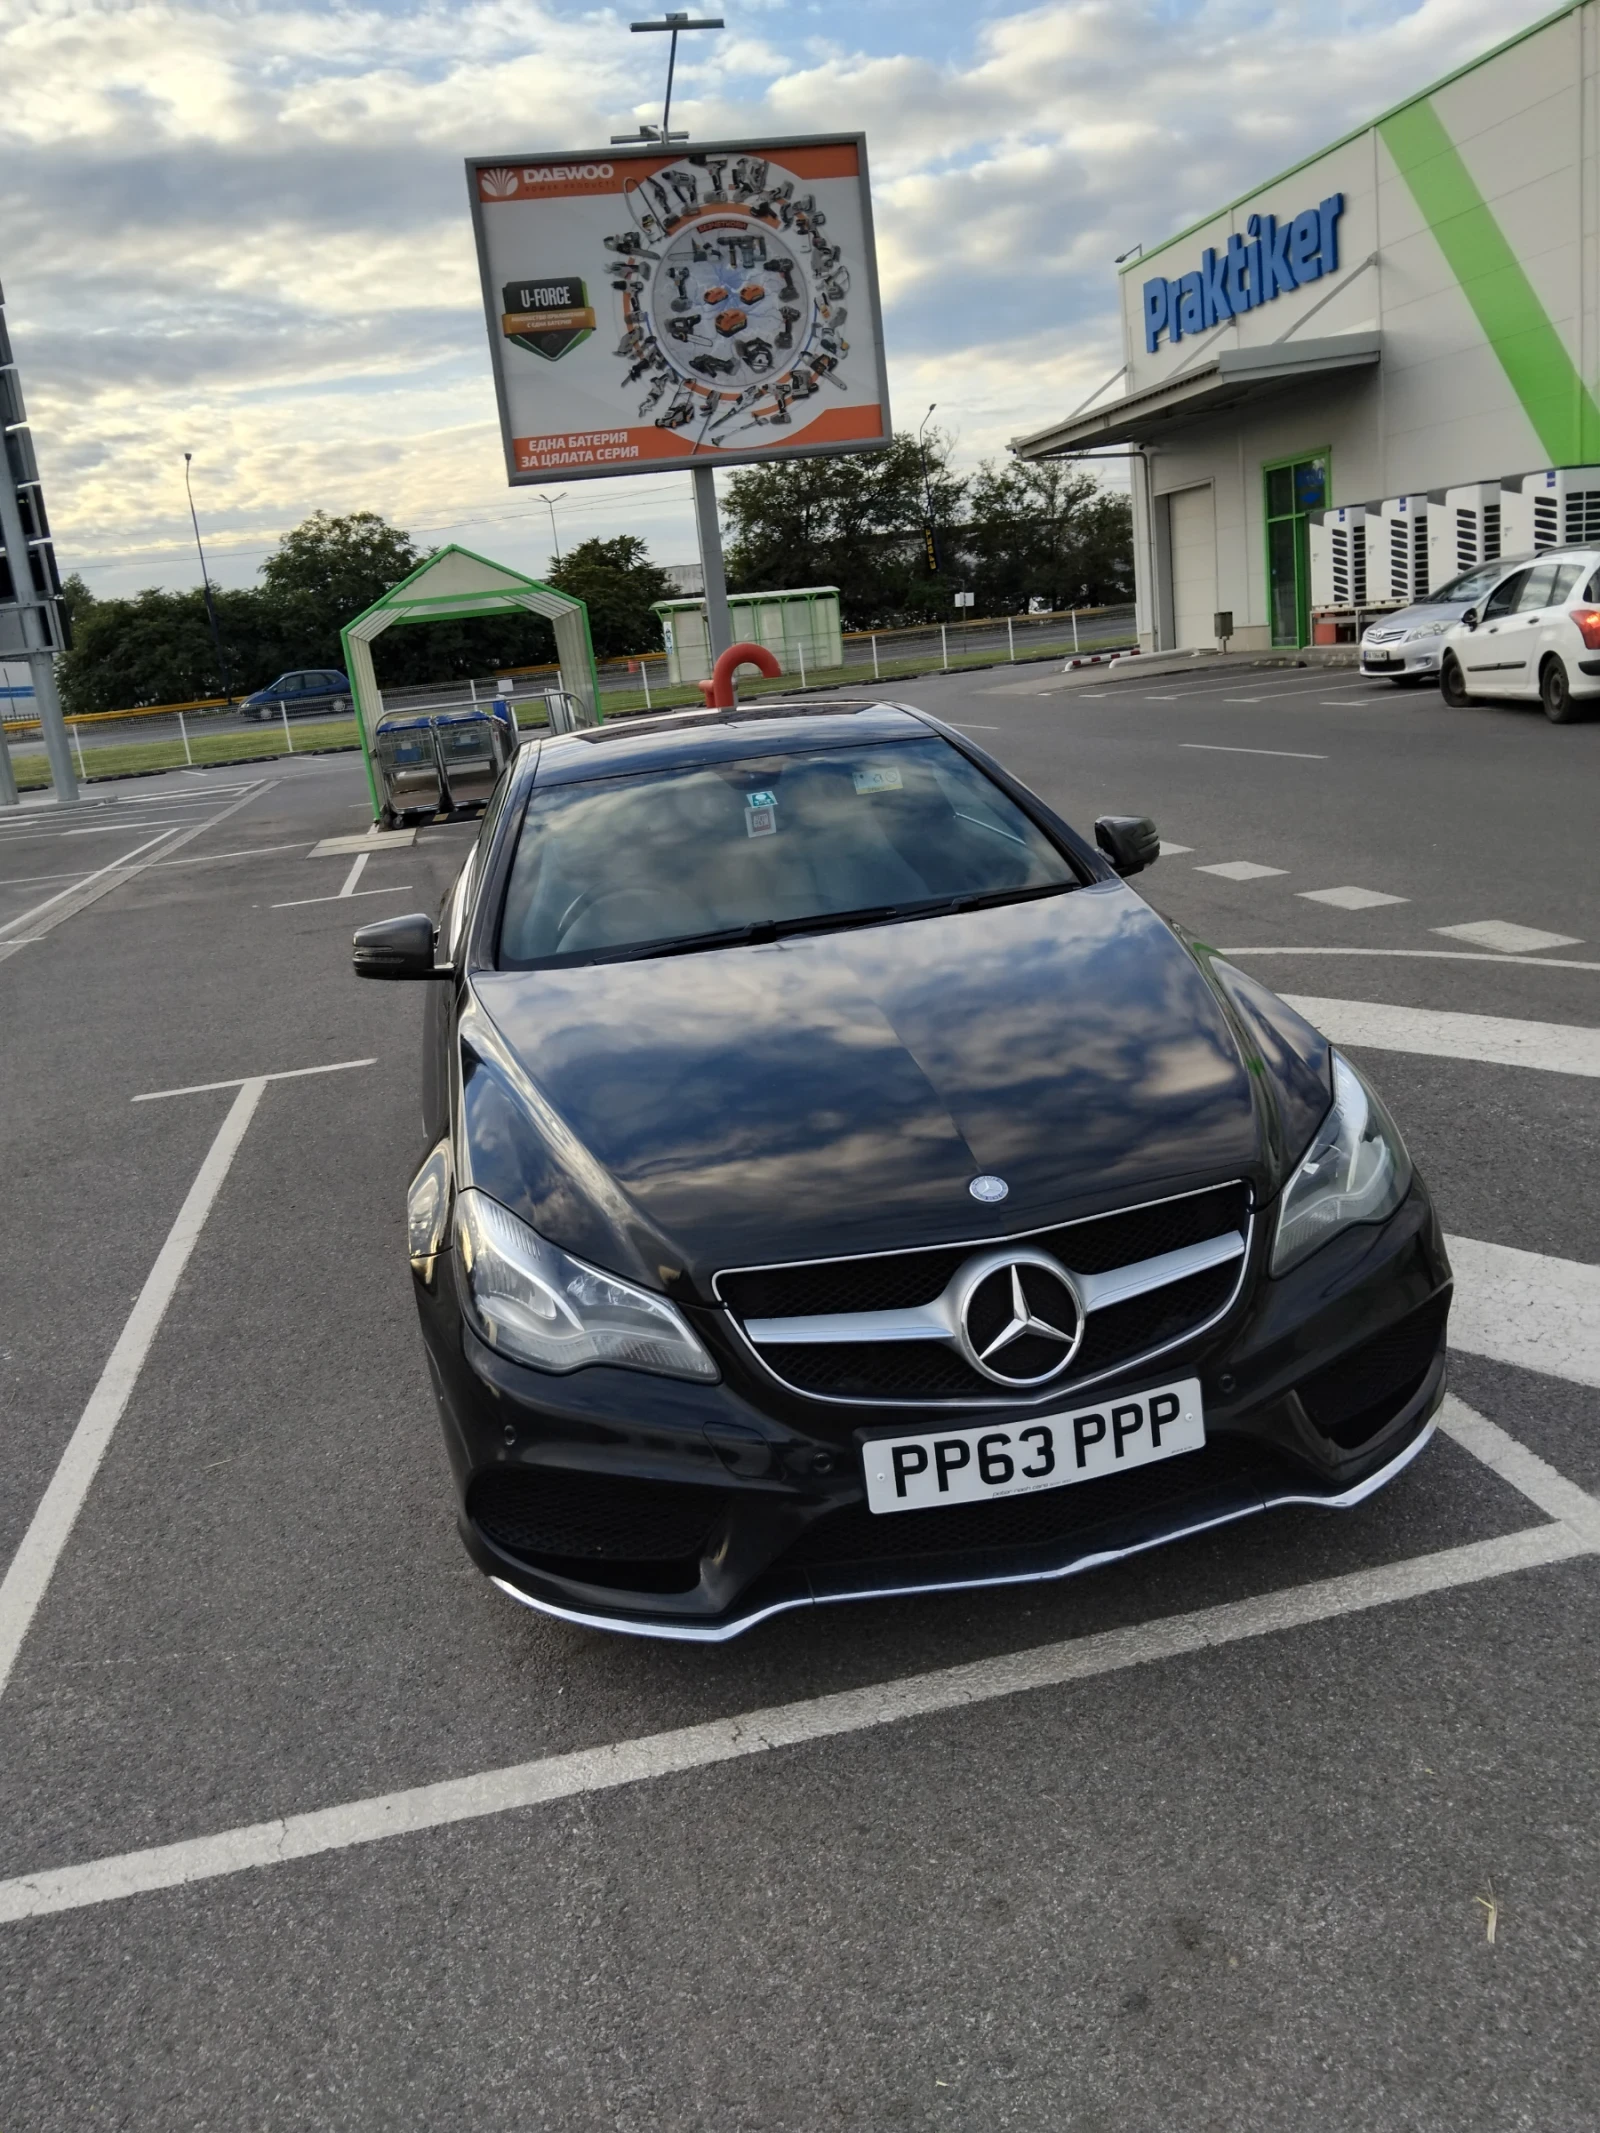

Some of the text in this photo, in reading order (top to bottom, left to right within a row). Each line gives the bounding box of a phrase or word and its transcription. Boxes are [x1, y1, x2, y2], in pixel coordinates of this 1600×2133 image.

[523, 164, 614, 183] DAEWOO
[1143, 192, 1345, 354] Praktiker
[520, 286, 572, 308] U-FORCE
[529, 431, 628, 453] ЕДНА БАТЕРИЯ
[521, 445, 639, 468] ЗА ЦЯЛАТА СЕРИЯ
[892, 1392, 1180, 1498] PP63 PPP
